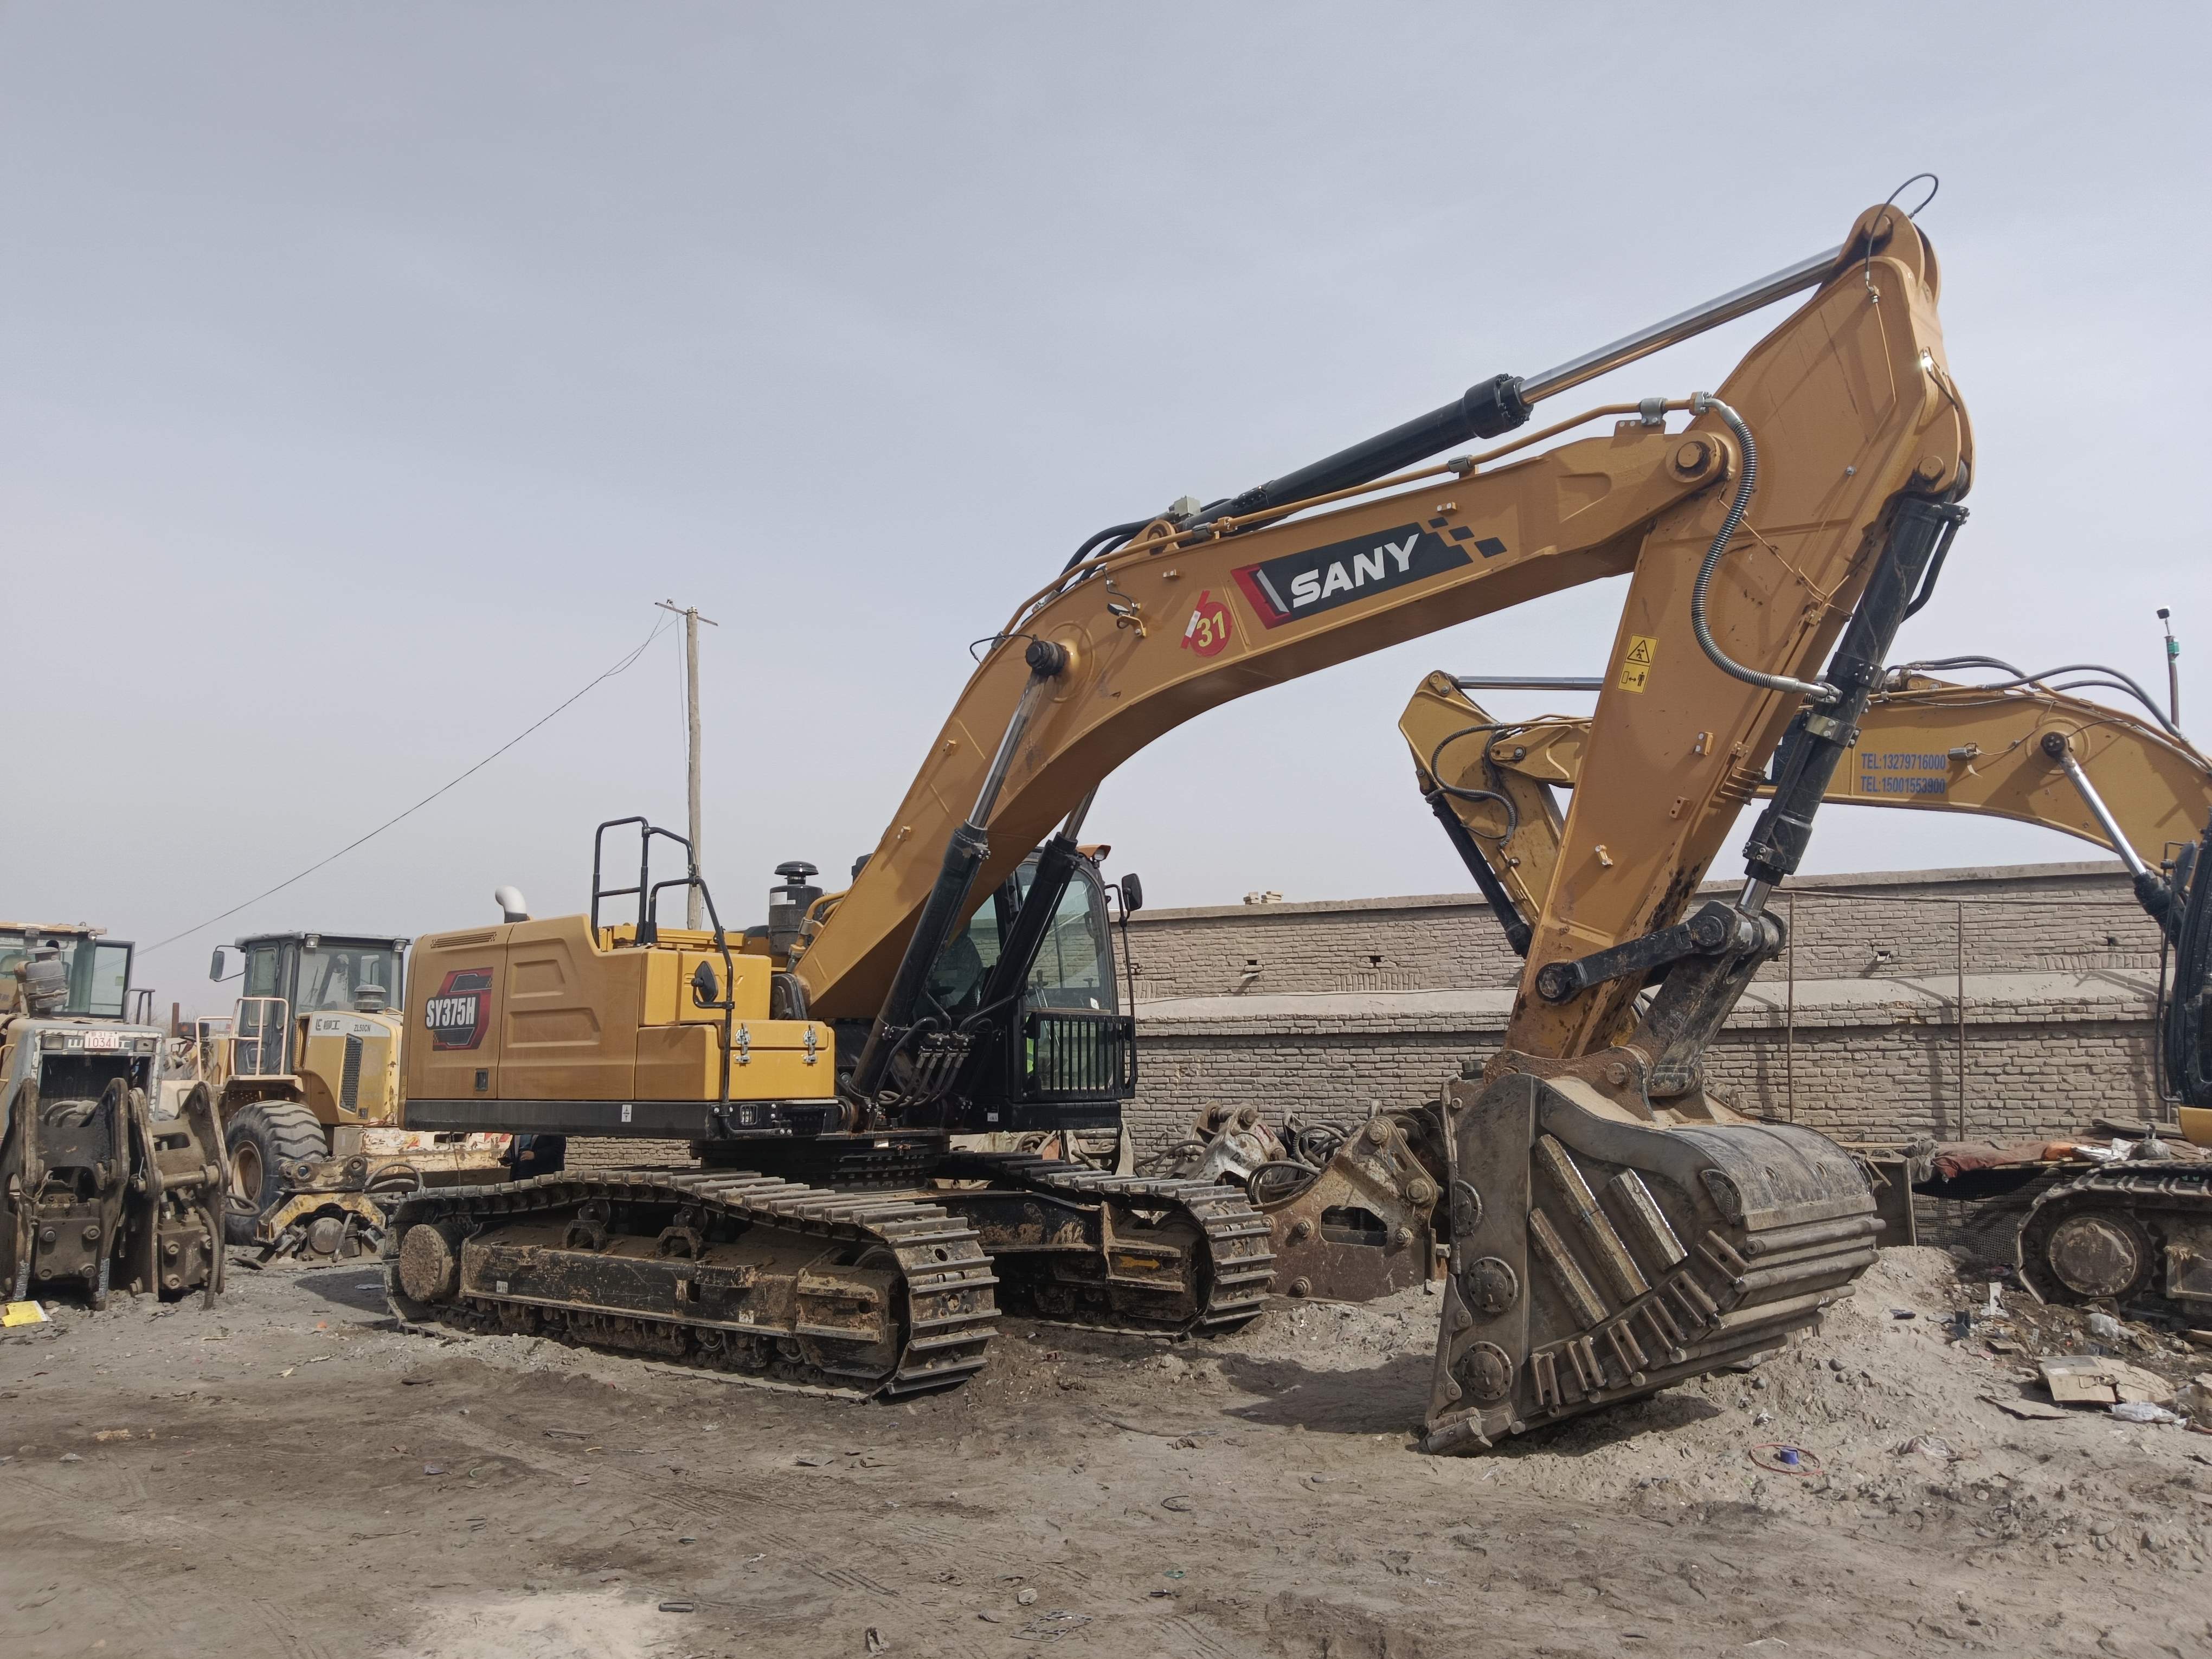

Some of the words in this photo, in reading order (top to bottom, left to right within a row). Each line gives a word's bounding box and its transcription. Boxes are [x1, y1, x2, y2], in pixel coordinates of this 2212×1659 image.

[1291, 533, 1419, 608] SANY
[1196, 610, 1225, 647] 31
[1861, 753, 1946, 770] TEL:13279716000
[426, 996, 476, 1028] SY375H
[88, 1037, 116, 1047] 10341
